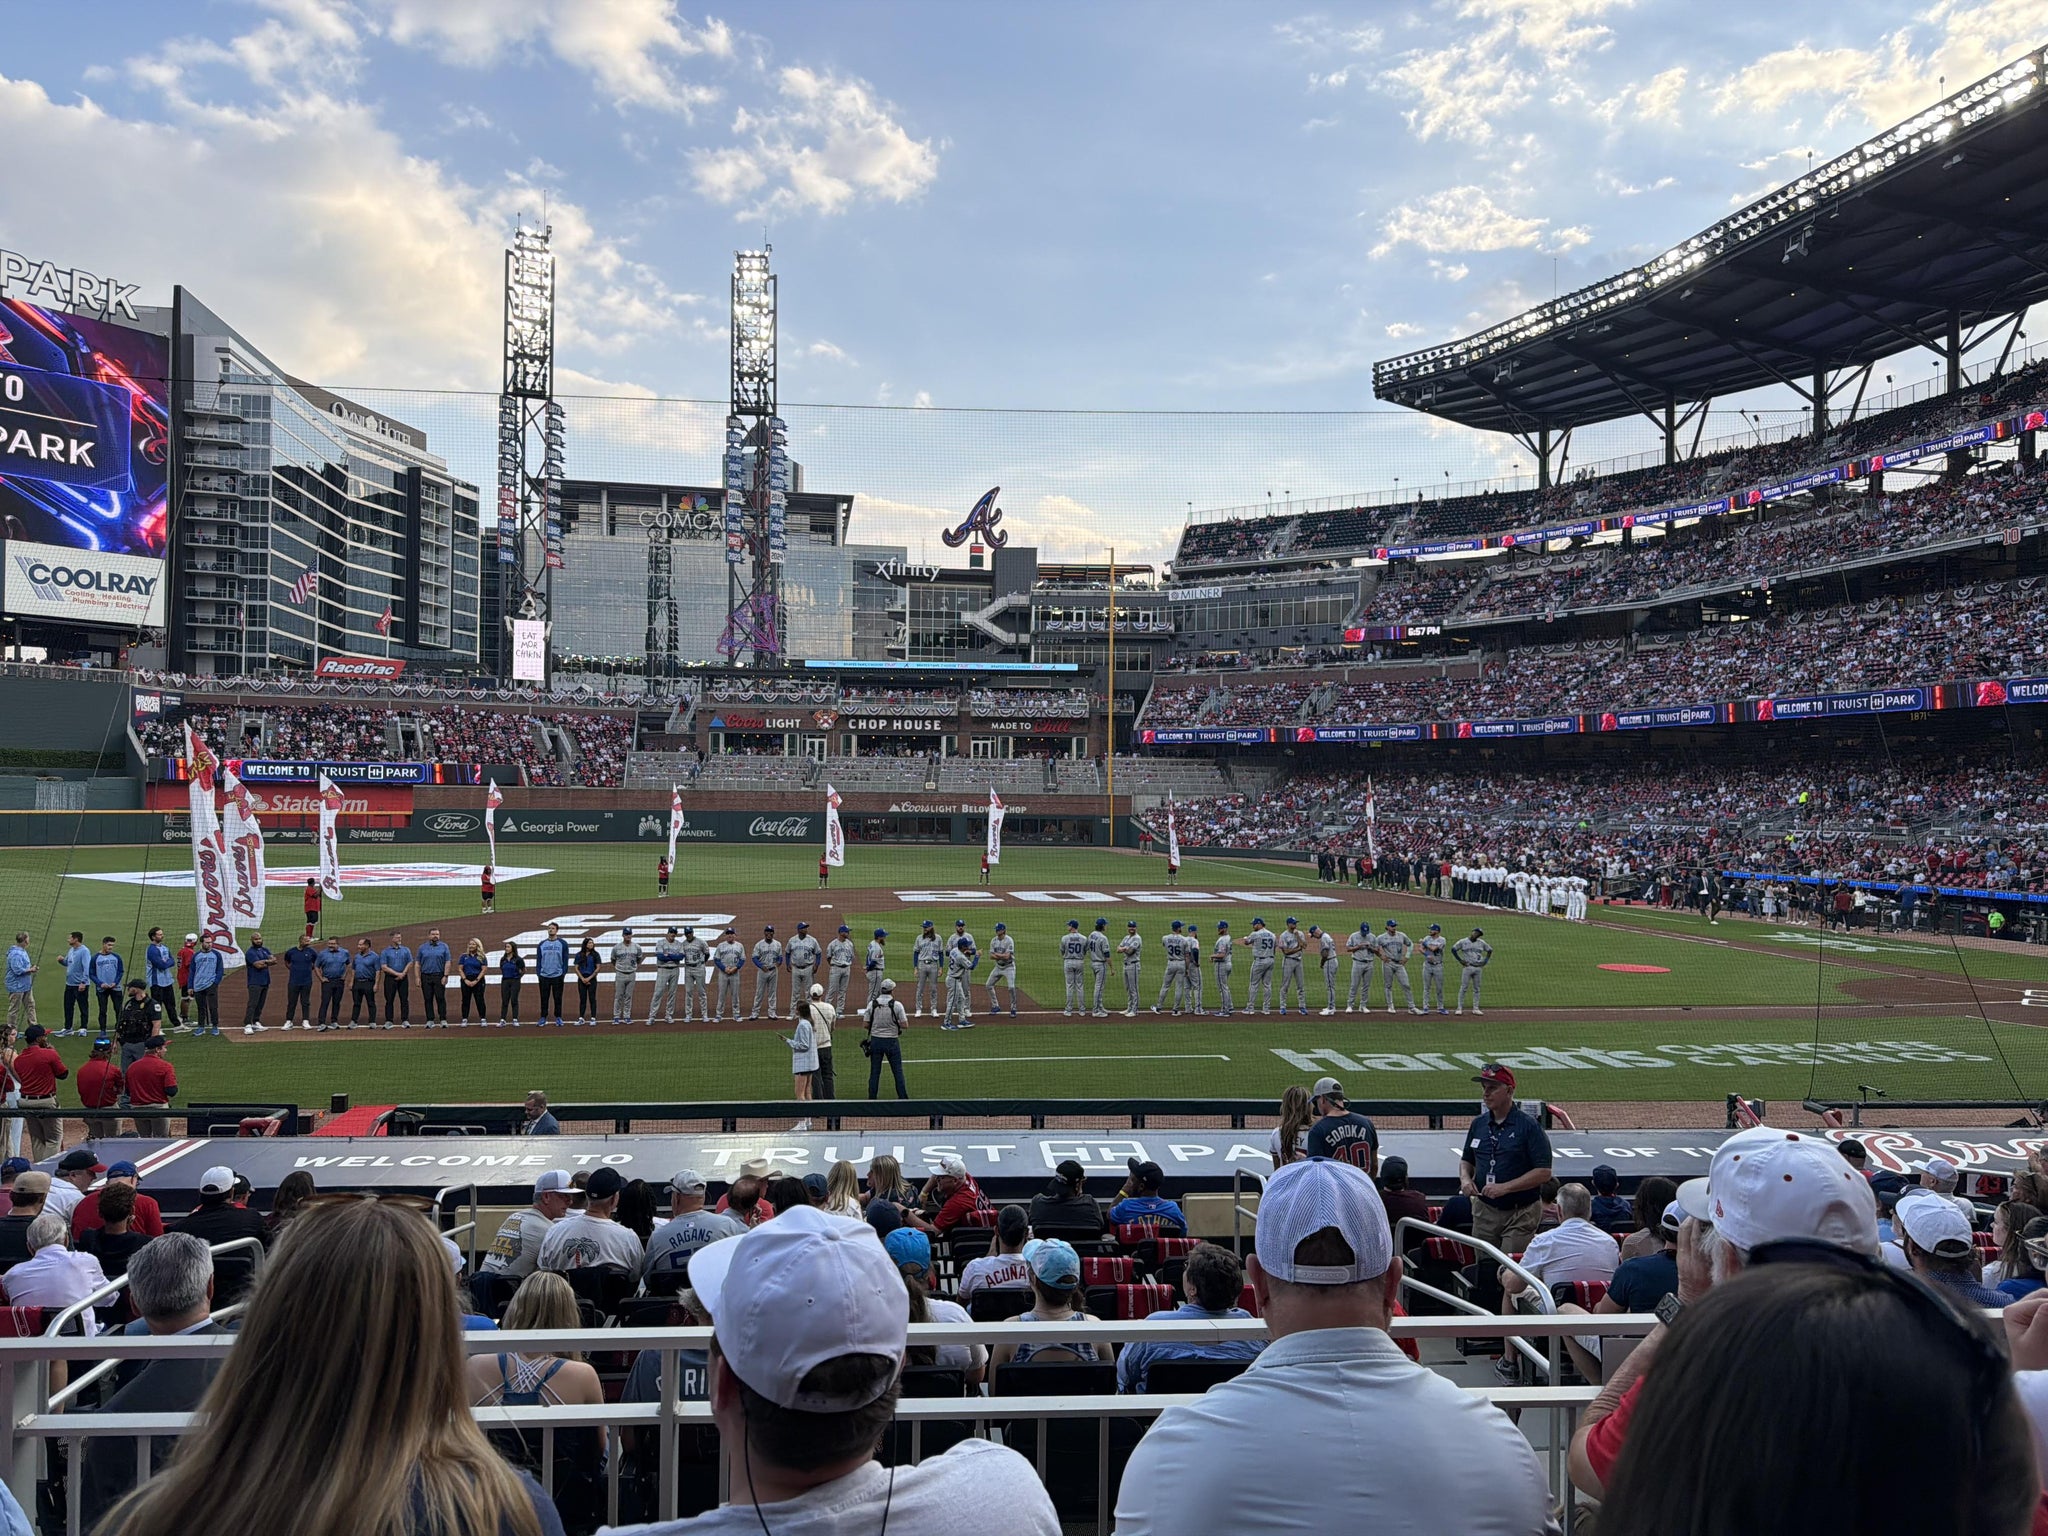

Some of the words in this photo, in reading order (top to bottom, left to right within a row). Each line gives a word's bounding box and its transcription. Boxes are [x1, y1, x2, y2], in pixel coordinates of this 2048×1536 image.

[0, 249, 141, 321] PARK
[0, 372, 24, 402] O
[502, 396, 516, 408] 1872
[548, 404, 562, 416] 1873
[331, 402, 366, 427] OMNI
[378, 418, 411, 446] HOTEL
[548, 420, 562, 430] 1875
[501, 428, 515, 440] 1877
[548, 434, 562, 446] 1878
[1926, 440, 1952, 454] TRUIST
[1964, 432, 1985, 443] PARK
[548, 449, 561, 460] 1891
[501, 460, 515, 470] 1892
[548, 465, 562, 476] 1893
[500, 474, 514, 486] 1897
[547, 480, 562, 490] 1898
[728, 477, 742, 488] 2004
[728, 492, 742, 502] 2010
[770, 492, 784, 502] 2012
[500, 506, 514, 516] 1957
[728, 506, 742, 517] 2013
[1674, 508, 1698, 517] TRUIST
[1708, 502, 1724, 512] PARK
[500, 521, 514, 531] 1969
[639, 511, 742, 531] COMCA
[770, 522, 784, 532] 2020
[1546, 529, 1566, 538] TRUIST
[1574, 526, 1589, 534] PARK
[2003, 527, 2021, 546] 10
[500, 536, 514, 546] 1991
[546, 540, 560, 551] 1992
[728, 536, 742, 546] 2021
[770, 537, 784, 547] 2022
[1456, 542, 1473, 550] PARK
[500, 551, 514, 562] 1993
[546, 556, 561, 566] 1995
[728, 551, 742, 562] 2023
[770, 552, 784, 562] 2024
[876, 557, 941, 582] xfinity
[28, 563, 157, 596] COOLRAY
[64, 588, 96, 599] Cooling
[102, 592, 132, 603] Heating
[1180, 588, 1220, 600] MILNER
[72, 597, 108, 608] Plumbing
[522, 632, 538, 640] EAT
[1408, 627, 1425, 636] 6:57
[1426, 626, 1440, 635] PM
[520, 641, 538, 649] MOR
[516, 650, 542, 659] CHIKIN
[322, 660, 395, 676] RaceTrac
[136, 694, 160, 704] BRAVES
[1776, 702, 1810, 714] WELCOME
[1813, 701, 1823, 711] TO
[1832, 698, 1868, 710] TRUIST
[1886, 694, 1915, 706] PARK
[136, 702, 160, 713] VISION
[726, 713, 764, 728] Coors
[766, 718, 801, 728] LIGHT
[1620, 716, 1642, 725] WELCOME
[1644, 715, 1650, 723] TO
[1656, 712, 1680, 722] TRUIST
[1691, 710, 1711, 720] PARK
[1910, 712, 1927, 721] 1871
[848, 719, 887, 730] CHOP
[892, 719, 942, 730] HOUSE
[992, 721, 1018, 730] MADE
[1020, 721, 1032, 730] TO
[1474, 726, 1504, 734] WELCOME
[1506, 724, 1514, 732] TO
[1522, 723, 1546, 732] TRUIST
[1553, 721, 1570, 730] PARK
[1158, 732, 1184, 740] WELCOME
[1185, 732, 1193, 740] TO
[1200, 732, 1225, 740] TRUIST
[1238, 732, 1258, 740] PARK
[1319, 730, 1346, 738] WELCOME
[1348, 730, 1356, 738] TO
[1363, 730, 1388, 738] TRUIST
[1398, 729, 1416, 737] PARK
[247, 765, 294, 776] WELCOME
[297, 766, 310, 776] TO
[322, 766, 366, 777] TRUIST
[386, 767, 418, 778] PARK
[900, 801, 929, 813] Coors
[930, 805, 956, 813] LIGHT
[962, 805, 992, 814] BELOW
[1004, 804, 1027, 814] CHOP
[434, 816, 470, 831] Ford
[521, 822, 564, 834] Georgia
[567, 822, 600, 832] Power
[749, 816, 811, 837] Coca-Cola
[163, 829, 192, 840] globa
[360, 830, 396, 838] National
[231, 845, 256, 918] Braves
[198, 845, 239, 955] Braves
[893, 890, 1346, 902] 2026
[1068, 943, 1082, 954] 50
[1262, 938, 1274, 950] 53
[1168, 945, 1180, 956] 36
[1655, 1040, 1952, 1055] CHEROKEE
[1269, 1046, 1677, 1073] Harrah's
[1687, 1050, 1992, 1067] CASINOS
[1326, 1124, 1367, 1147] SOROKA
[293, 1155, 553, 1168] WELCOME
[571, 1154, 634, 1165] TO
[700, 1144, 1017, 1166] TRUIST
[1602, 1147, 1660, 1158] OF
[1671, 1146, 1722, 1157] TH
[1332, 1140, 1370, 1175] 40
[668, 1228, 714, 1249] RAGANS
[986, 1263, 1027, 1289] ACUÑA
